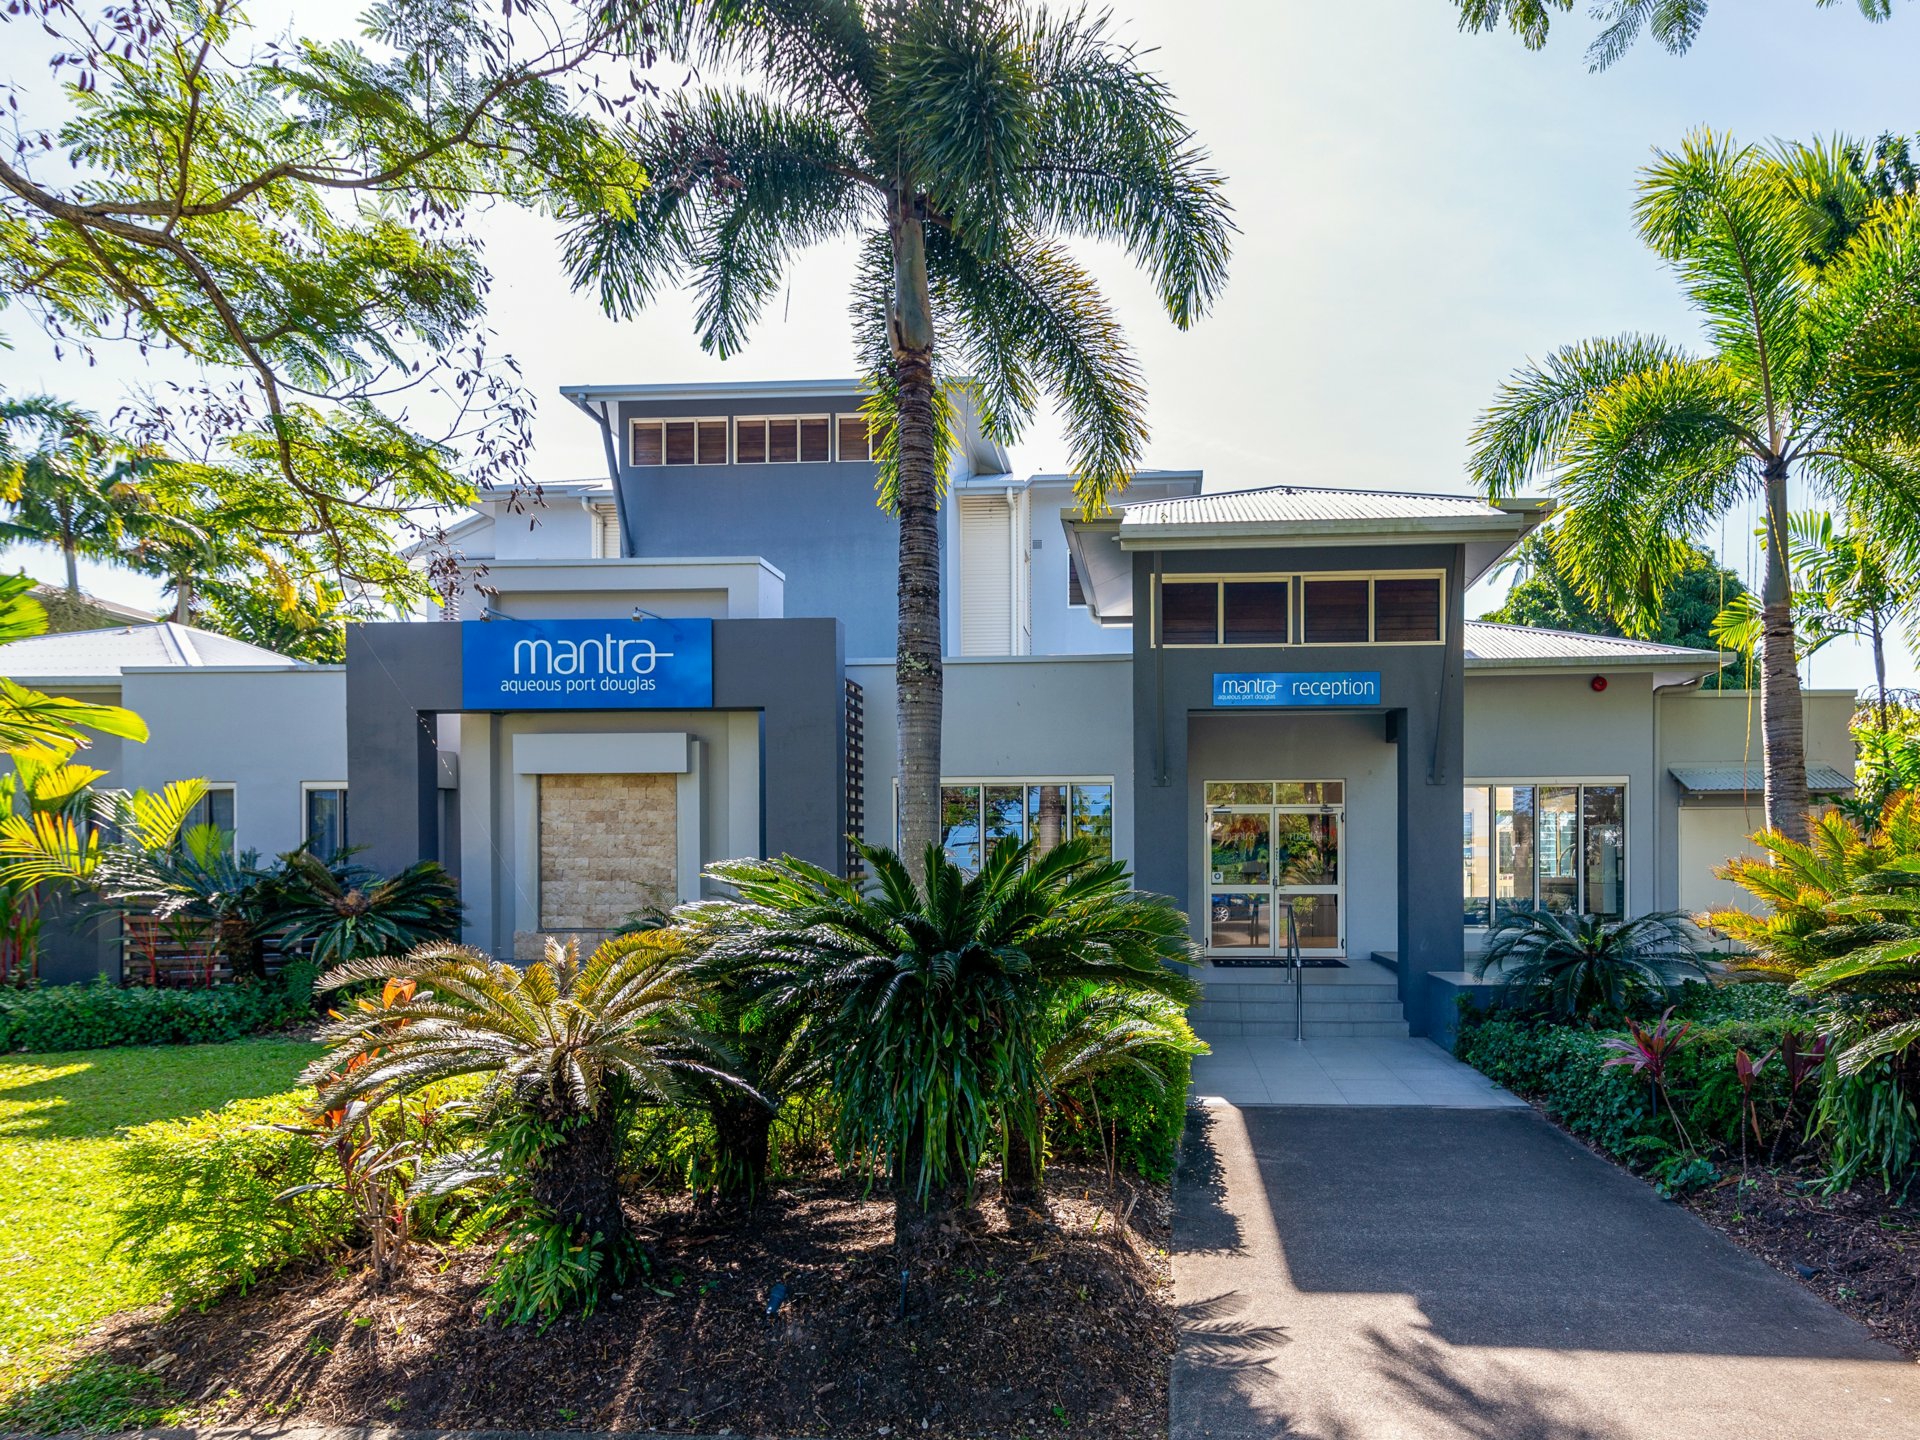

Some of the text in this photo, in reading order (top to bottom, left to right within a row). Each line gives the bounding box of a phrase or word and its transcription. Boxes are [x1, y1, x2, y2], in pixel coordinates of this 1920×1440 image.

[514, 633, 674, 674] mantra
[500, 676, 656, 694] aqueous port douglas
[1222, 678, 1283, 694] mantra
[1292, 678, 1374, 699] reception
